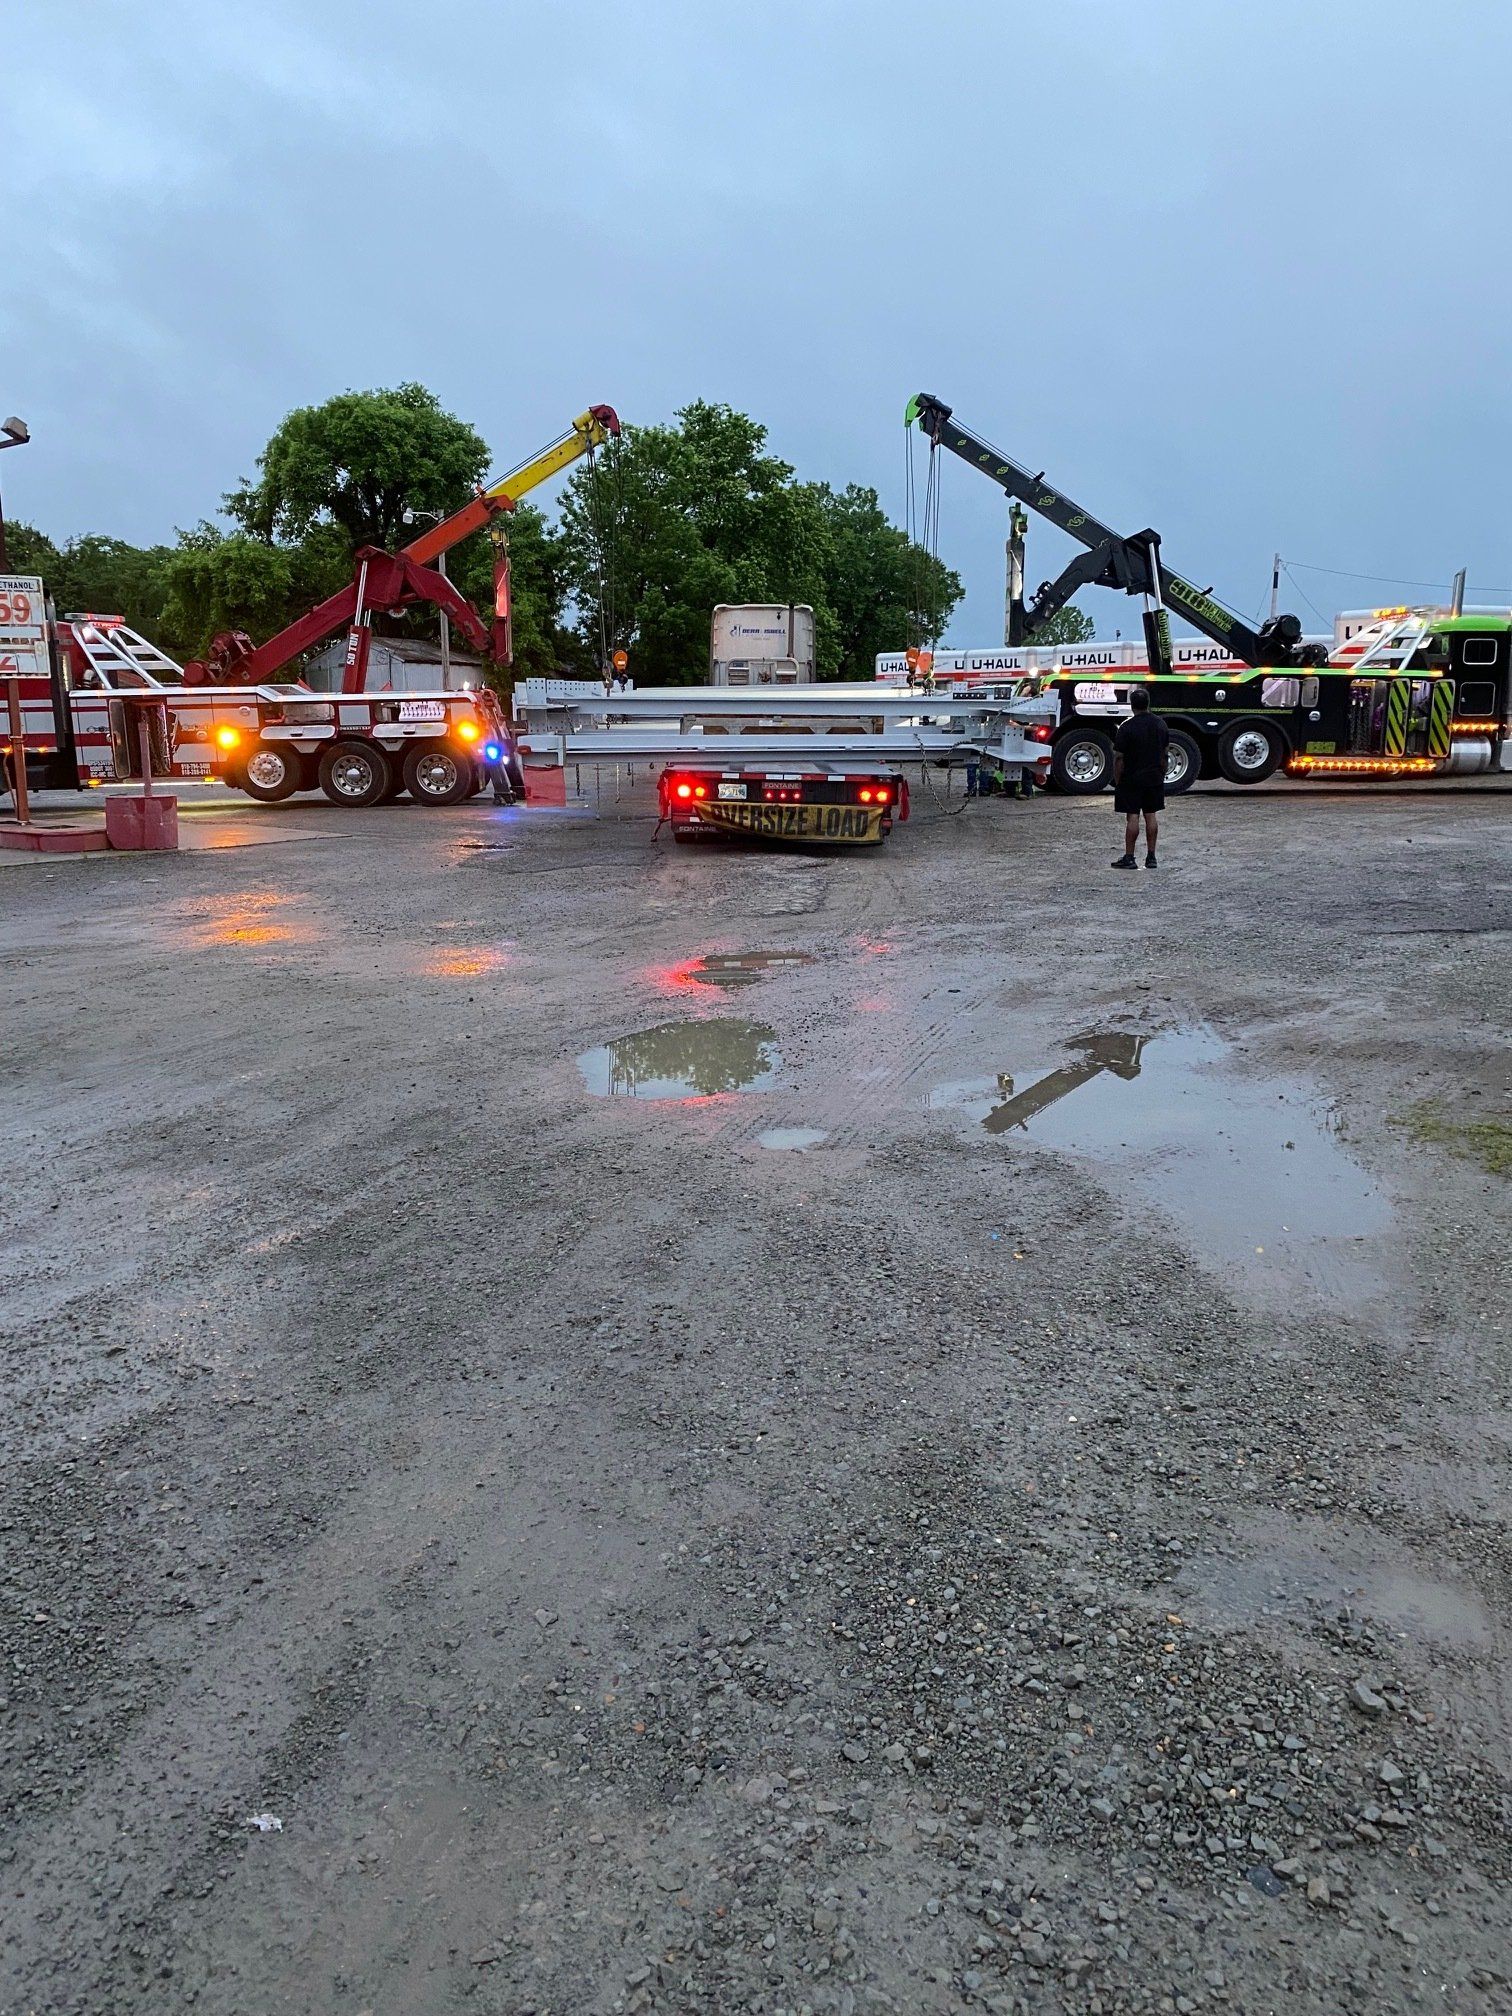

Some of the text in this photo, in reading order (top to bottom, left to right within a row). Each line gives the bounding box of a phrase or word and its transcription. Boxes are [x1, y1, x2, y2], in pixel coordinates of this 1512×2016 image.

[349, 633, 359, 651] TON
[972, 658, 1021, 670] U-HAUL
[1062, 653, 1116, 666] U-HAUL
[710, 804, 868, 837] OVERSIZE LOAD
